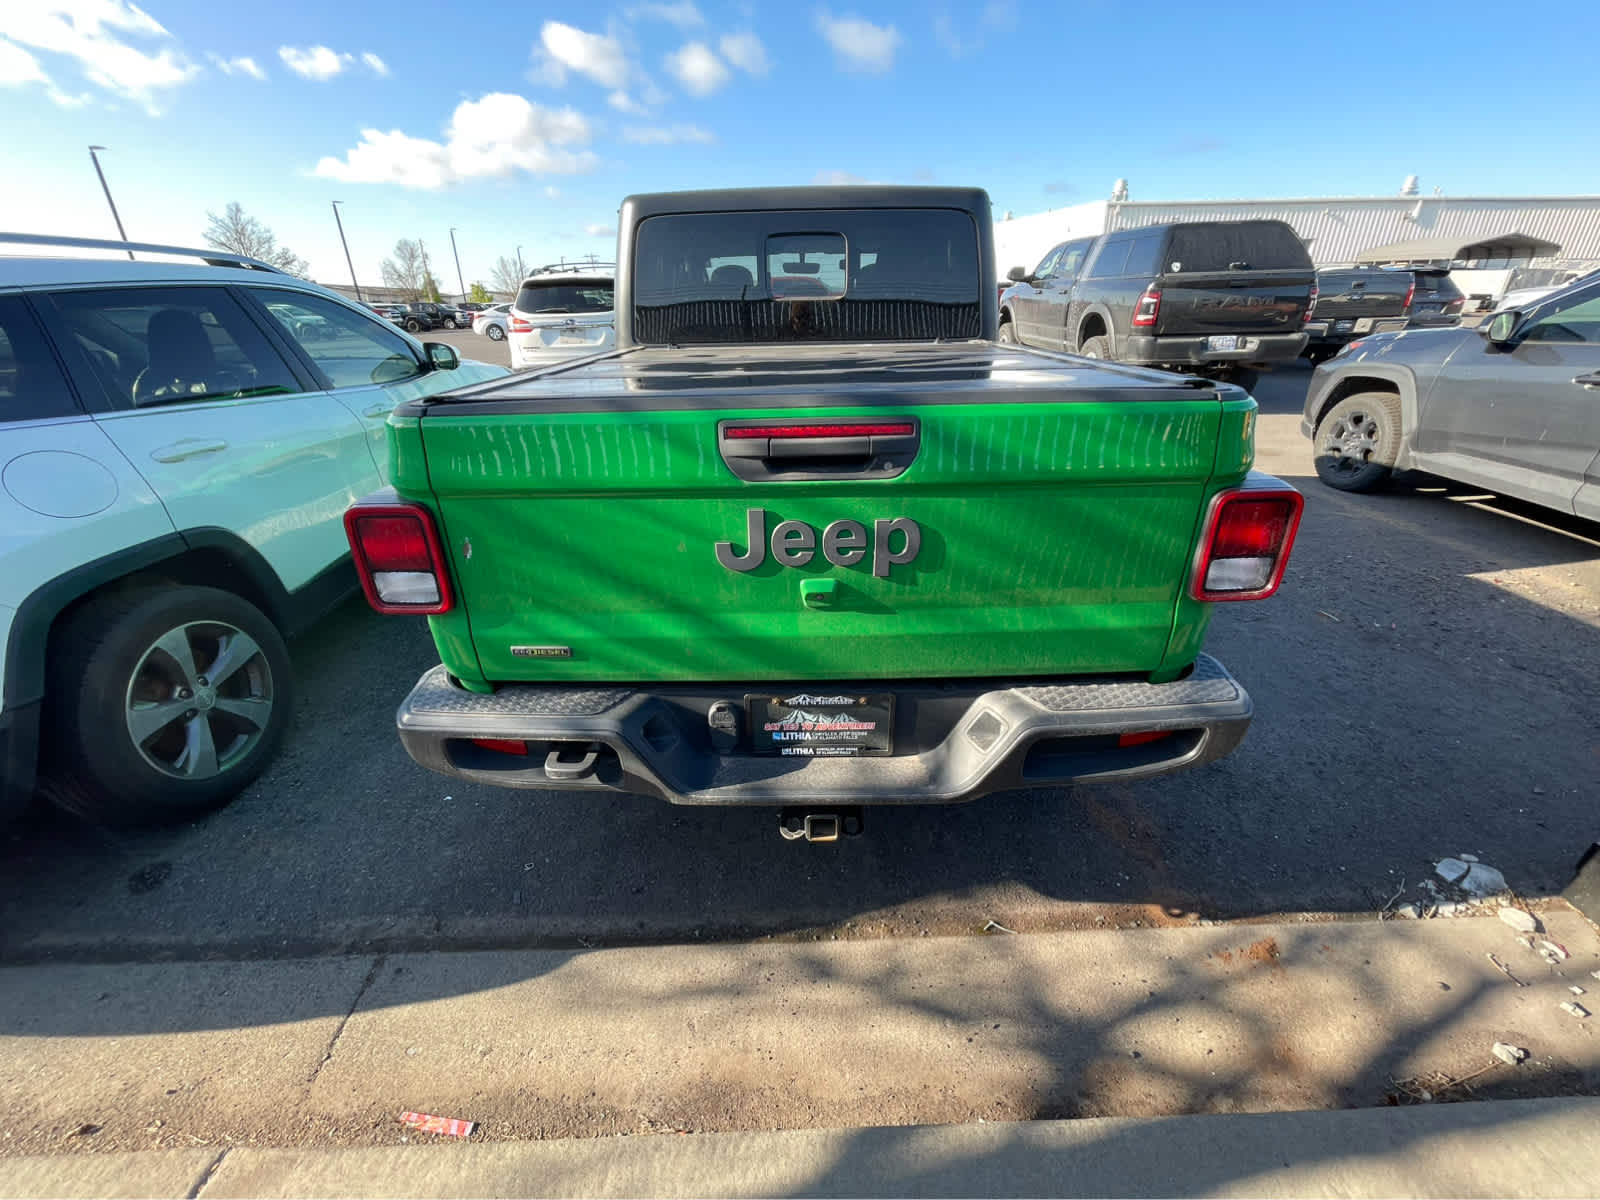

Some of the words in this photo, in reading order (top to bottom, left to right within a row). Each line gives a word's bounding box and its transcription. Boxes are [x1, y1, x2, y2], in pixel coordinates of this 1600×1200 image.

[1191, 295, 1276, 311] RAM
[714, 507, 921, 577] Jeep
[781, 731, 812, 740] LITHIA
[790, 747, 815, 755] LITHIA
